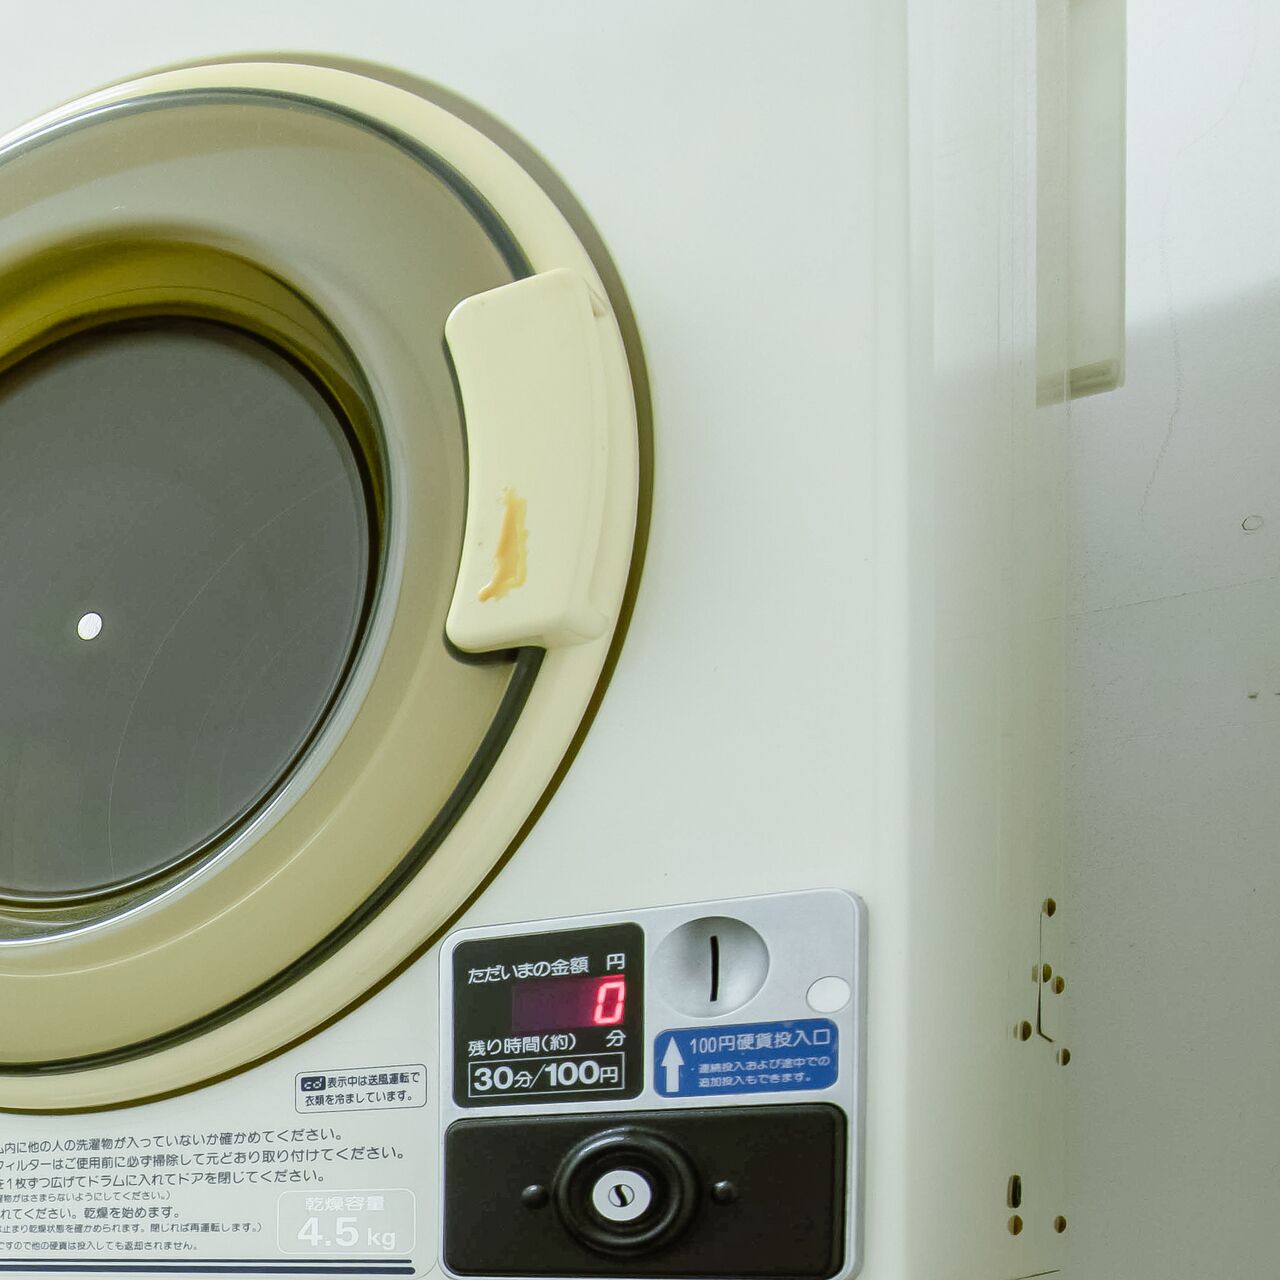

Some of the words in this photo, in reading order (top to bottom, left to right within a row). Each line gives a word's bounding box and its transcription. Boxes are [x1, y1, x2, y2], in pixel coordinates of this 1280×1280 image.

[468, 955, 589, 985] ただいまの金額
[606, 952, 626, 970] 円
[594, 980, 626, 1025] 0
[468, 1032, 577, 1054] 残り時間(約)
[606, 1029, 627, 1048] 分
[690, 1028, 831, 1054] 100円硬貨投入口
[327, 1072, 420, 1090] 表示中は送風運転で
[473, 1061, 619, 1091] 30分/100円
[304, 1090, 413, 1107] 衣類を冷ましています。
[305, 1195, 385, 1213] 乾燥容量
[297, 1215, 359, 1247] 4.5
[367, 1227, 396, 1249] kg
